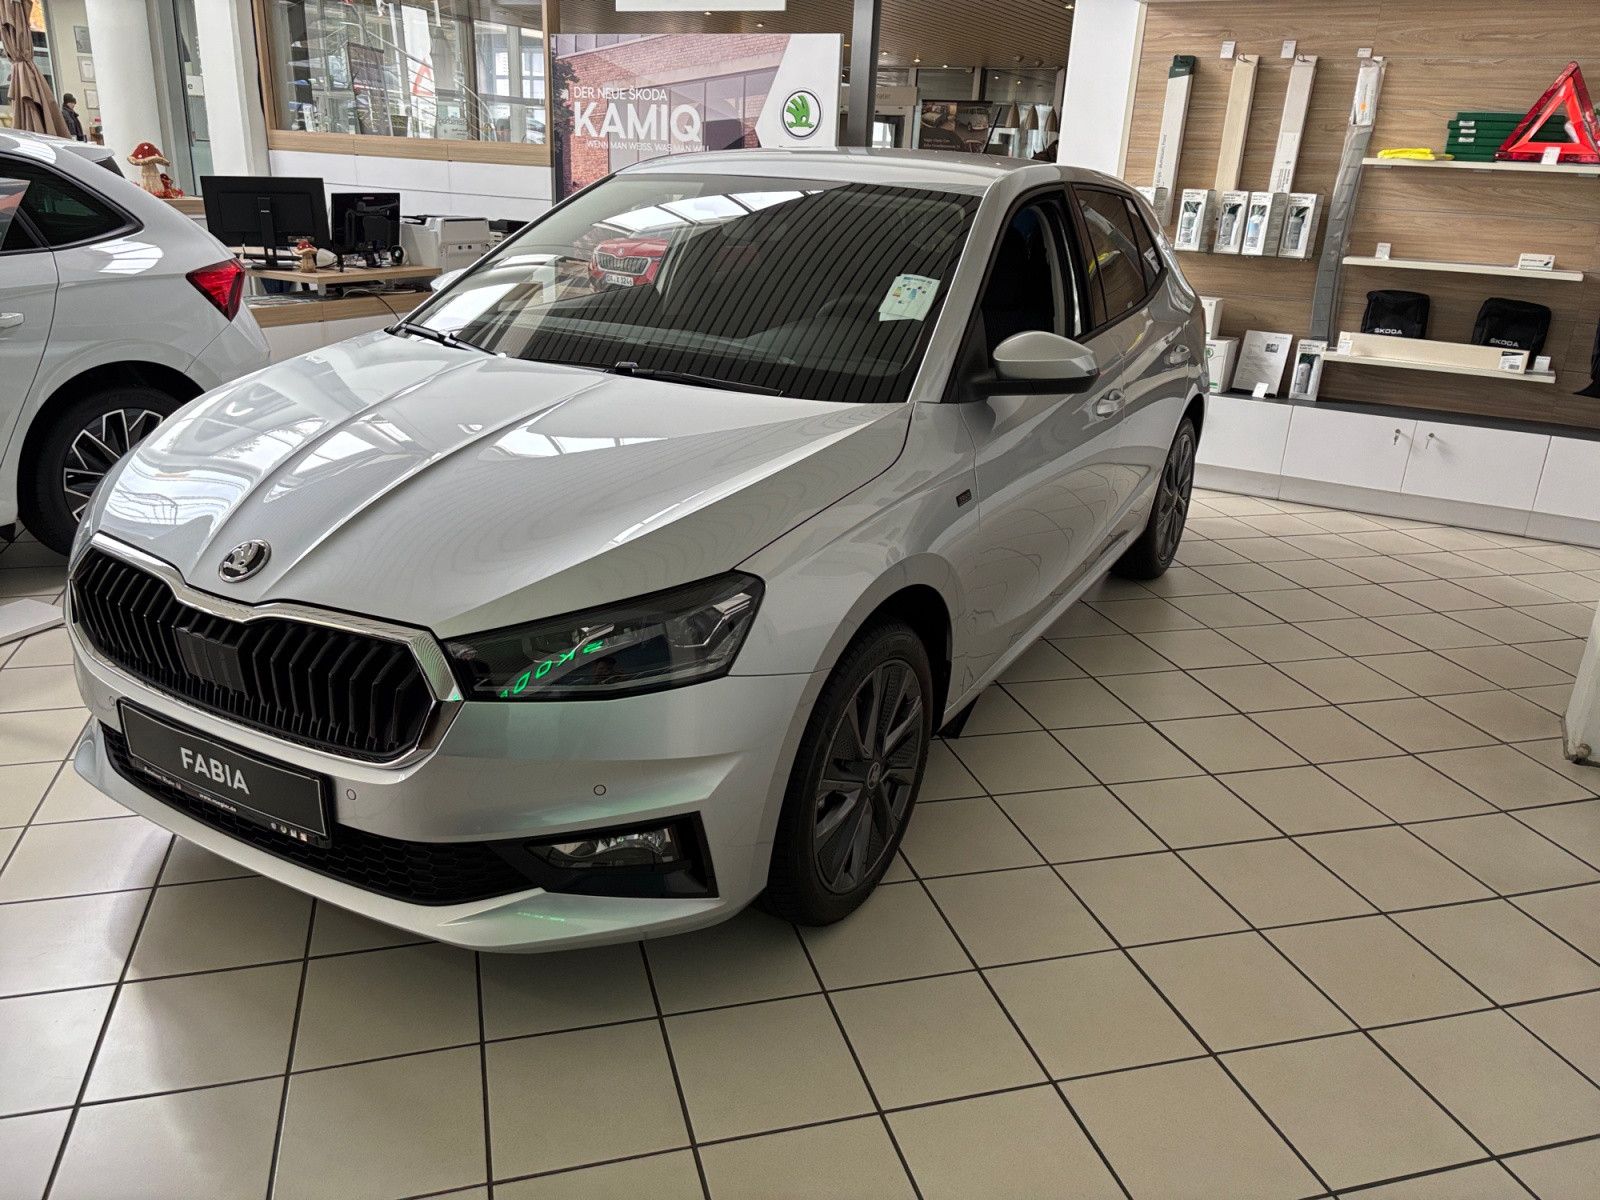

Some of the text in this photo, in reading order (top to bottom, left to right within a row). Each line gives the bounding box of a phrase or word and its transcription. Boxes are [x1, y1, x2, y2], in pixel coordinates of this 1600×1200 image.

[574, 86, 668, 101] DER NEUE ŠKODA
[574, 101, 702, 143] KAMIQ
[586, 140, 608, 150] WENN
[610, 141, 627, 151] MAN
[180, 747, 250, 795] FABIA
